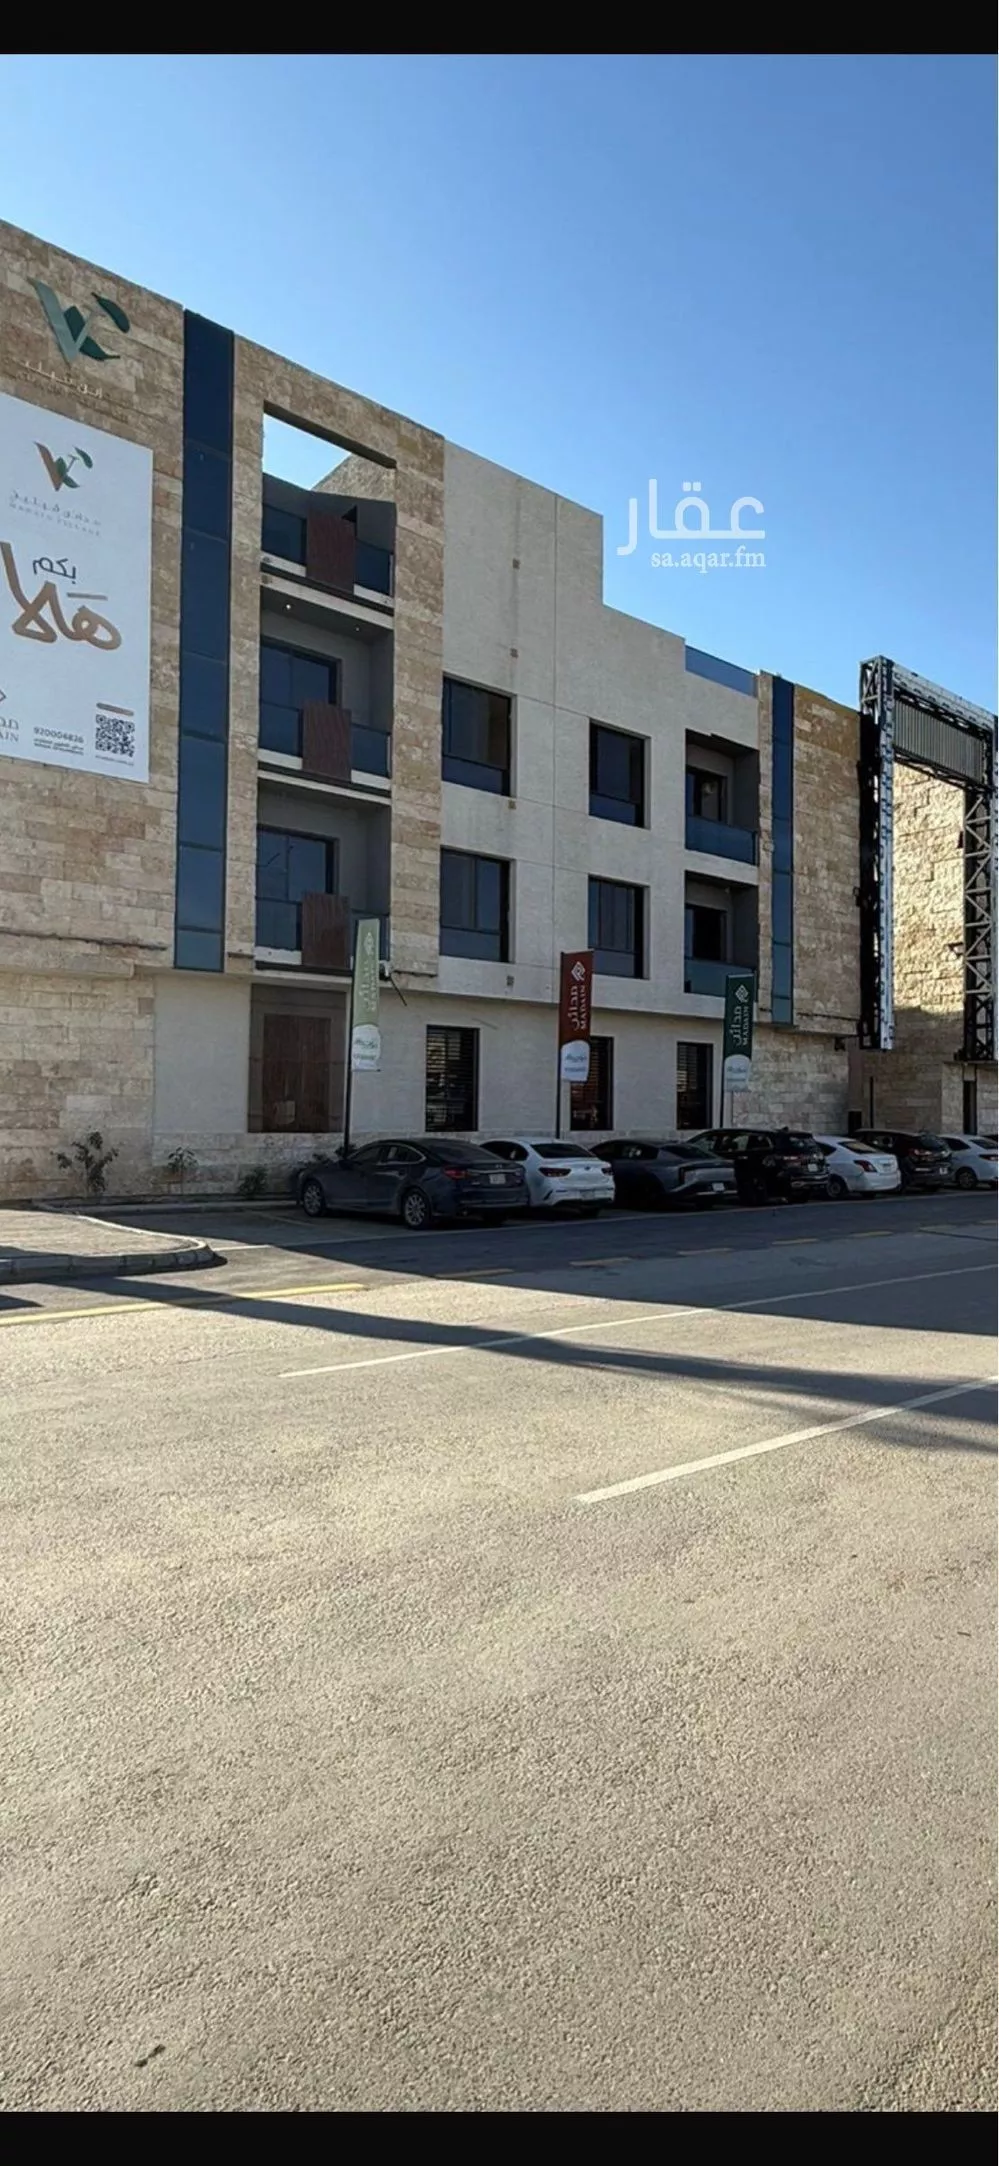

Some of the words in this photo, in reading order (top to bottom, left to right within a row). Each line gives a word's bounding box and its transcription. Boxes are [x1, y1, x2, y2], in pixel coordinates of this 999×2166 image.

[33, 557, 76, 584] بكم
[567, 985, 580, 1031] مدائن
[580, 985, 588, 1030] MADAIN
[729, 1005, 742, 1047] مدائن
[742, 1006, 750, 1046] MADAIN
